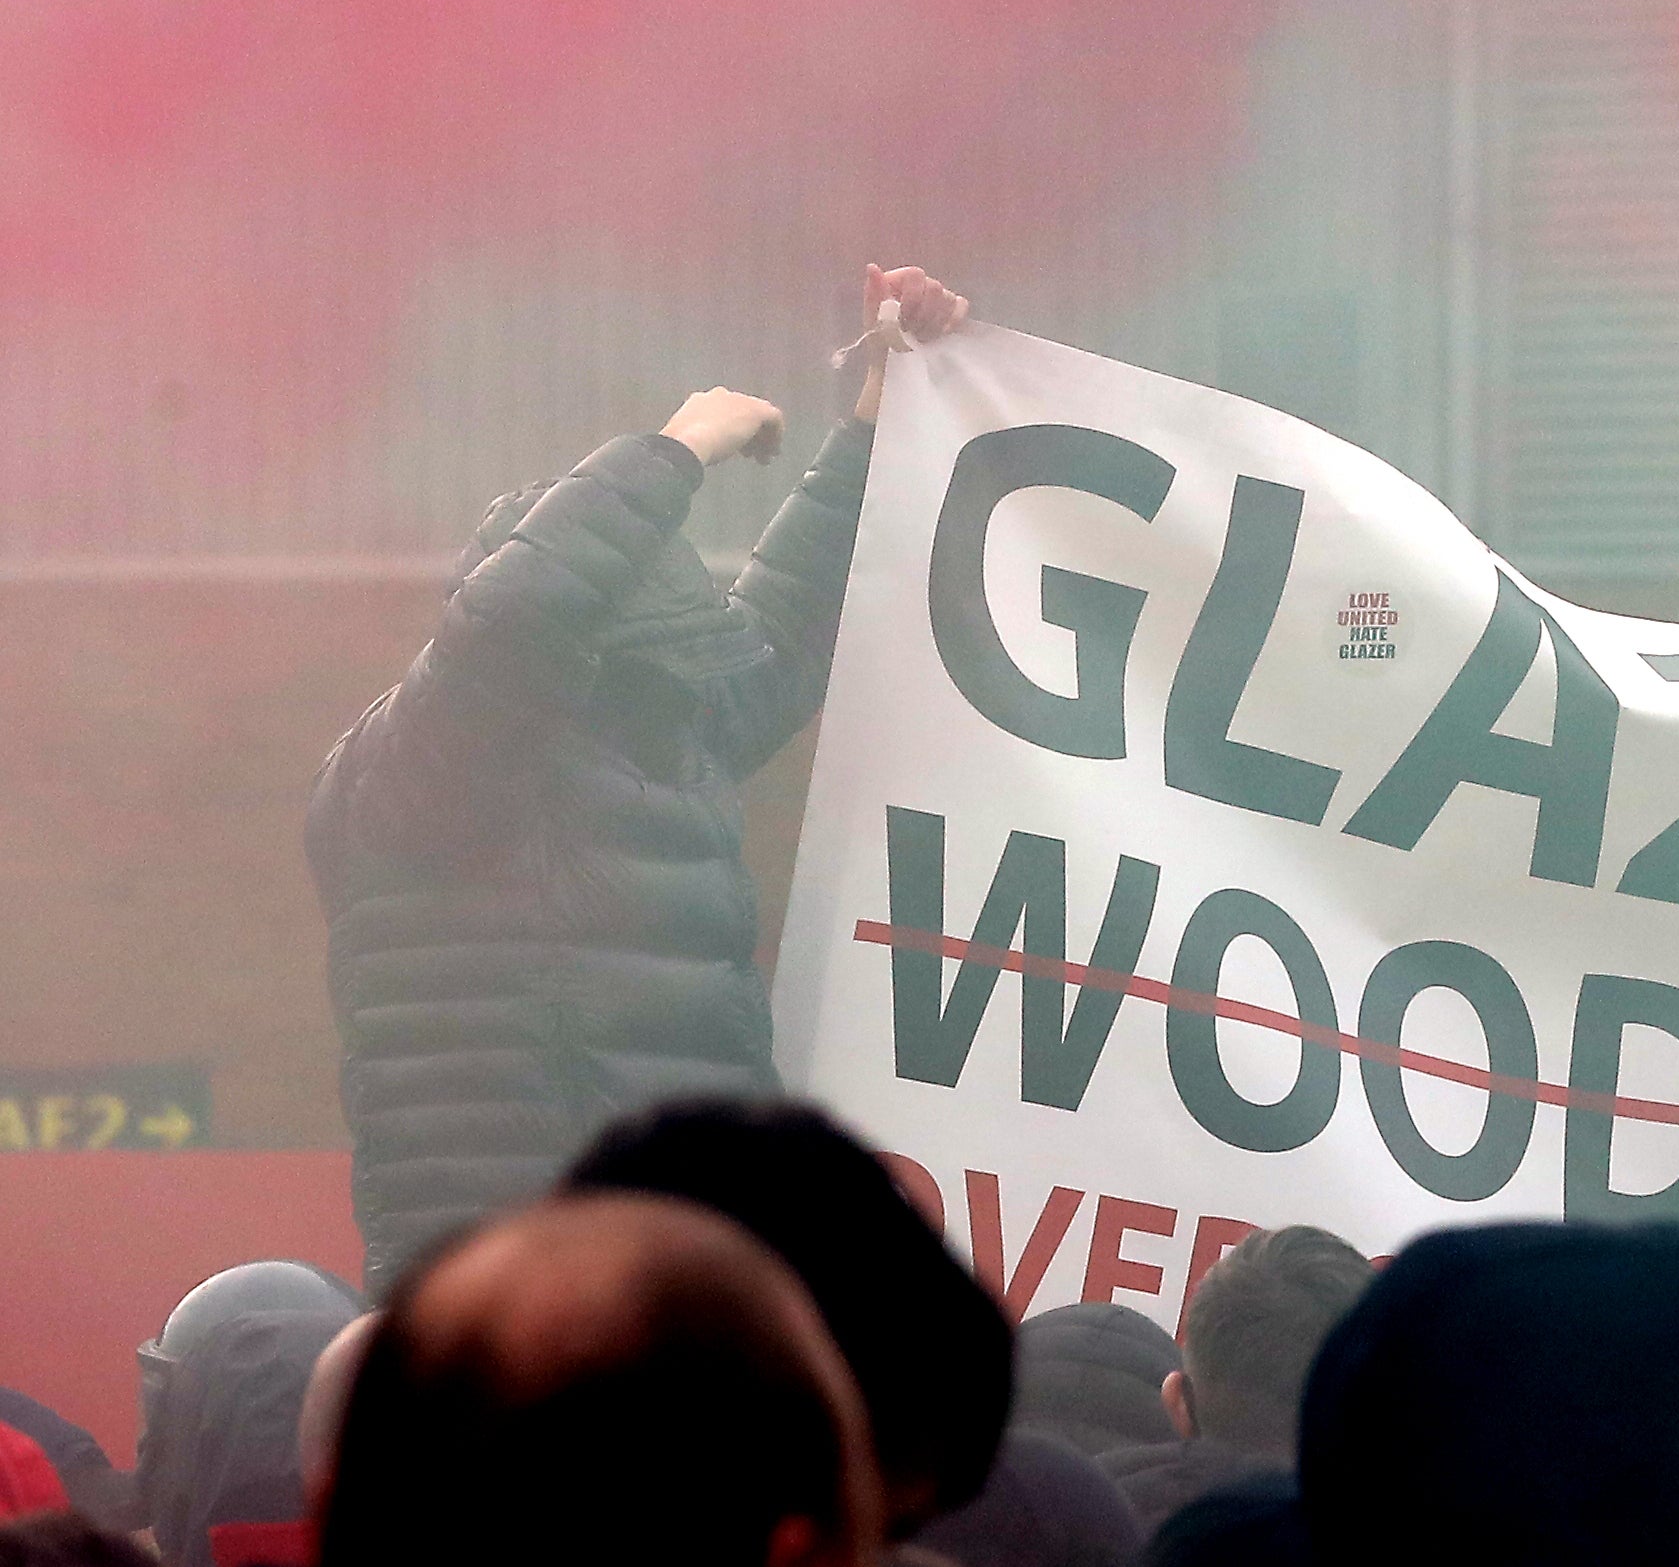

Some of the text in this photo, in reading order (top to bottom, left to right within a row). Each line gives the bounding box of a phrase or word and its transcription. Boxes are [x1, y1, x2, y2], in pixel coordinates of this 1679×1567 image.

[1348, 593, 1389, 608] LOVE
[1338, 611, 1398, 626] UNITED
[1350, 627, 1387, 641] HATE
[1339, 644, 1395, 659] GLAZER
